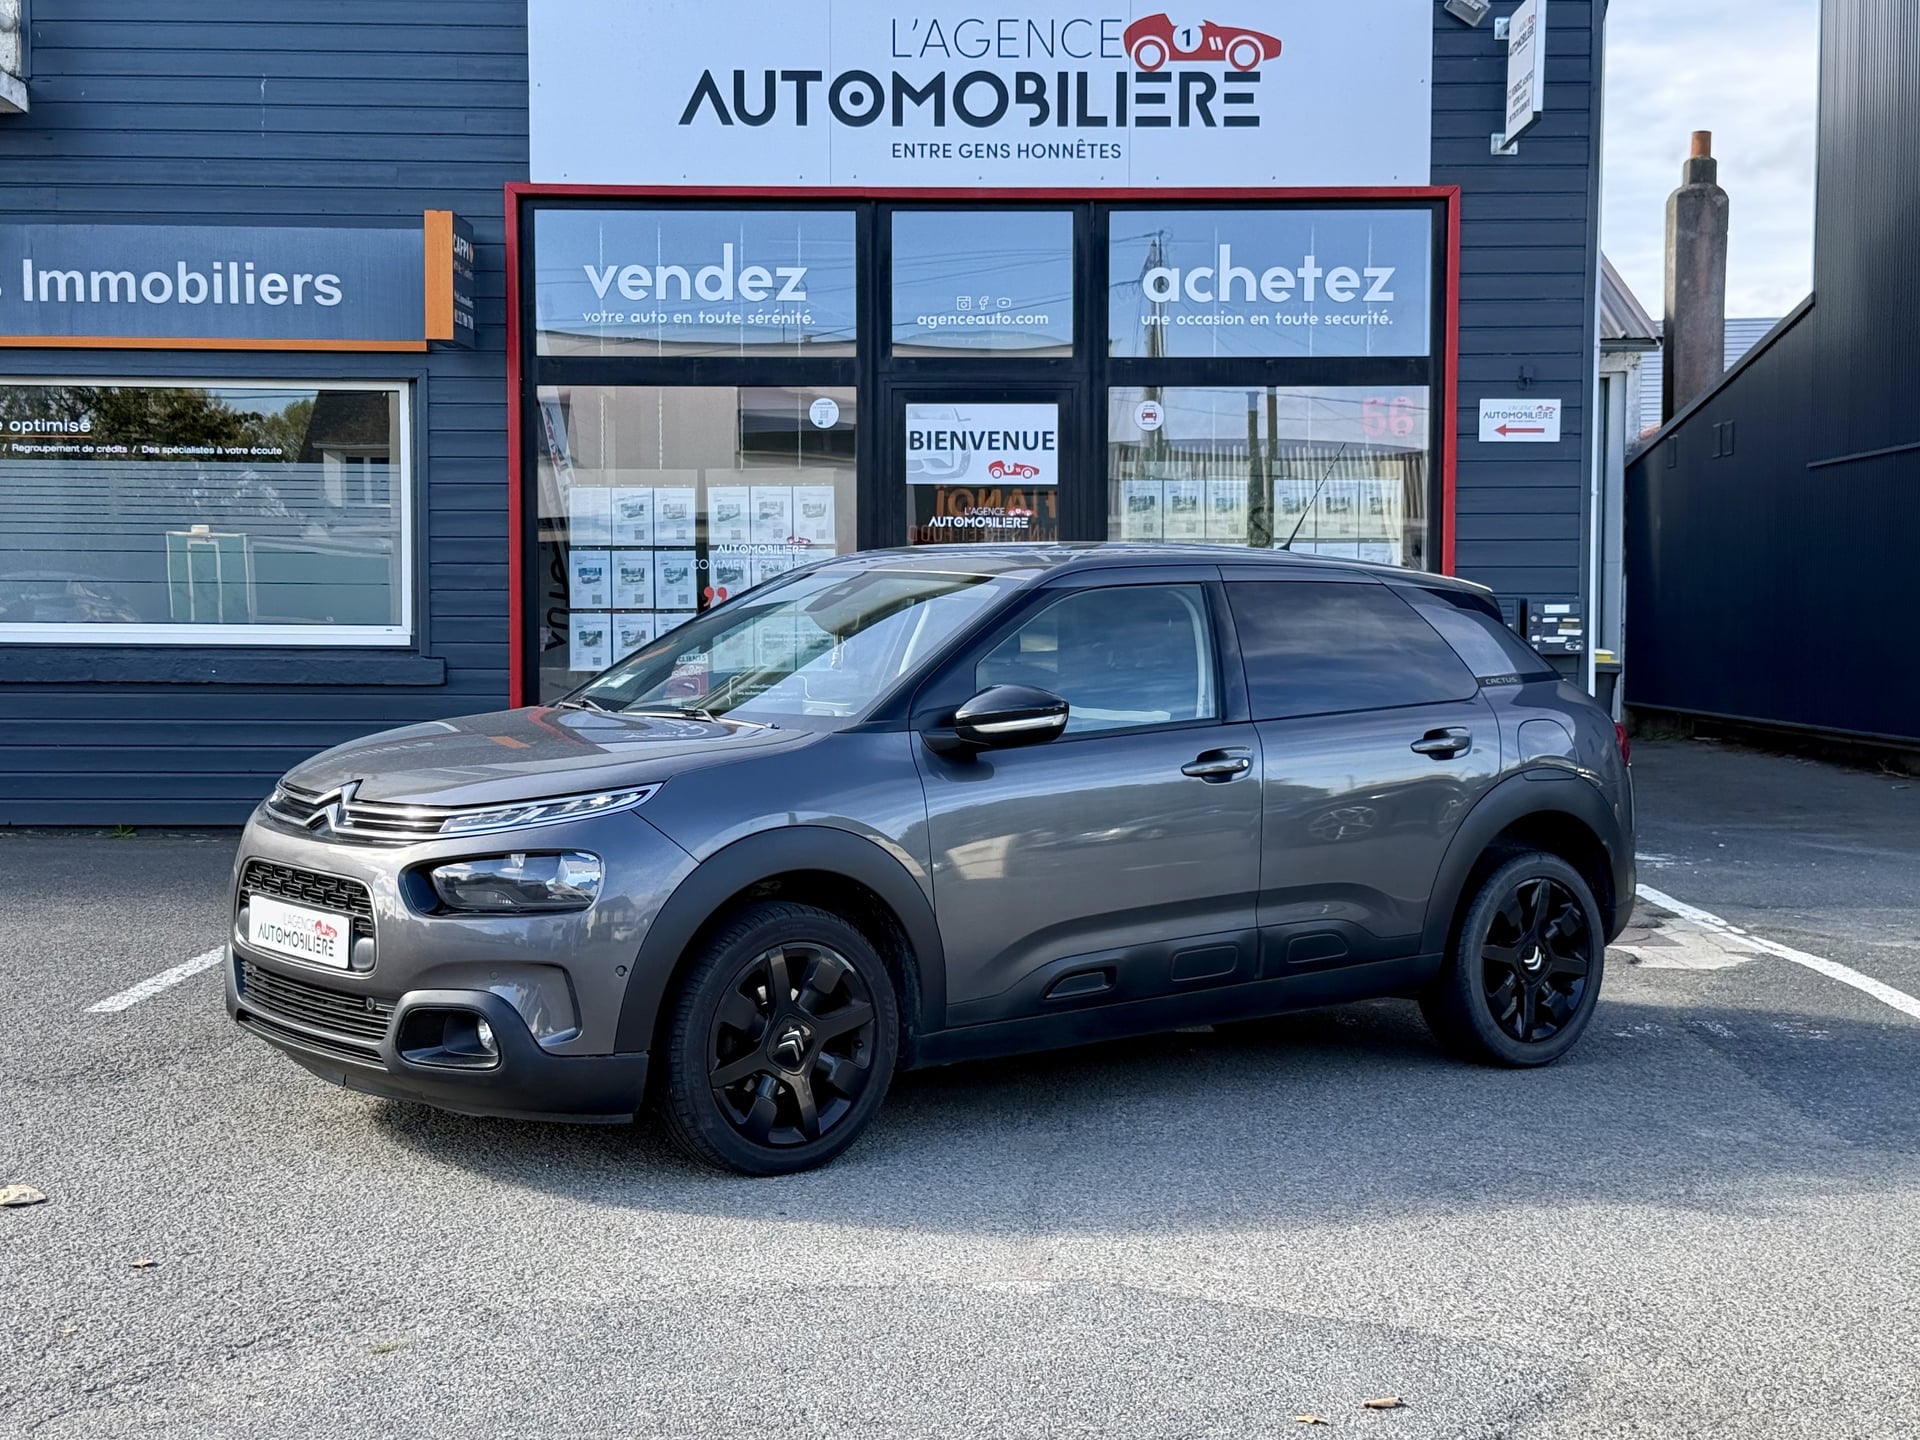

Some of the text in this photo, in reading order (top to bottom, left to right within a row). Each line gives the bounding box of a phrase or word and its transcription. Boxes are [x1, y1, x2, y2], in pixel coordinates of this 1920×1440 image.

[891, 18, 1124, 59] L'AGENCE
[1181, 28, 1192, 47] 1
[678, 69, 1262, 128] AUTOMOBILIERE
[892, 138, 1122, 159] ENTRE GENS HONNÊTES
[583, 243, 808, 302] vendez
[1142, 244, 1396, 303] achetez
[23, 258, 343, 306] Immobiliers
[583, 308, 816, 325] votre auto en toute sérénité.
[917, 313, 1049, 329] agenceauto.com
[1141, 309, 1393, 326] une occasion en toute securité.
[9, 418, 91, 435] optimisé
[12, 443, 80, 454] Regroupement
[82, 444, 94, 453] de
[96, 444, 128, 453] crédits
[141, 445, 160, 454] Des
[162, 445, 215, 456] spécialistes
[217, 445, 223, 454] à
[225, 446, 248, 455] votre
[250, 446, 283, 455] écoute
[909, 430, 1055, 451] BIENVENUE
[964, 506, 1006, 516] L'AGENCE
[690, 558, 757, 570] COMMENT
[1485, 677, 1517, 685] CACTUS
